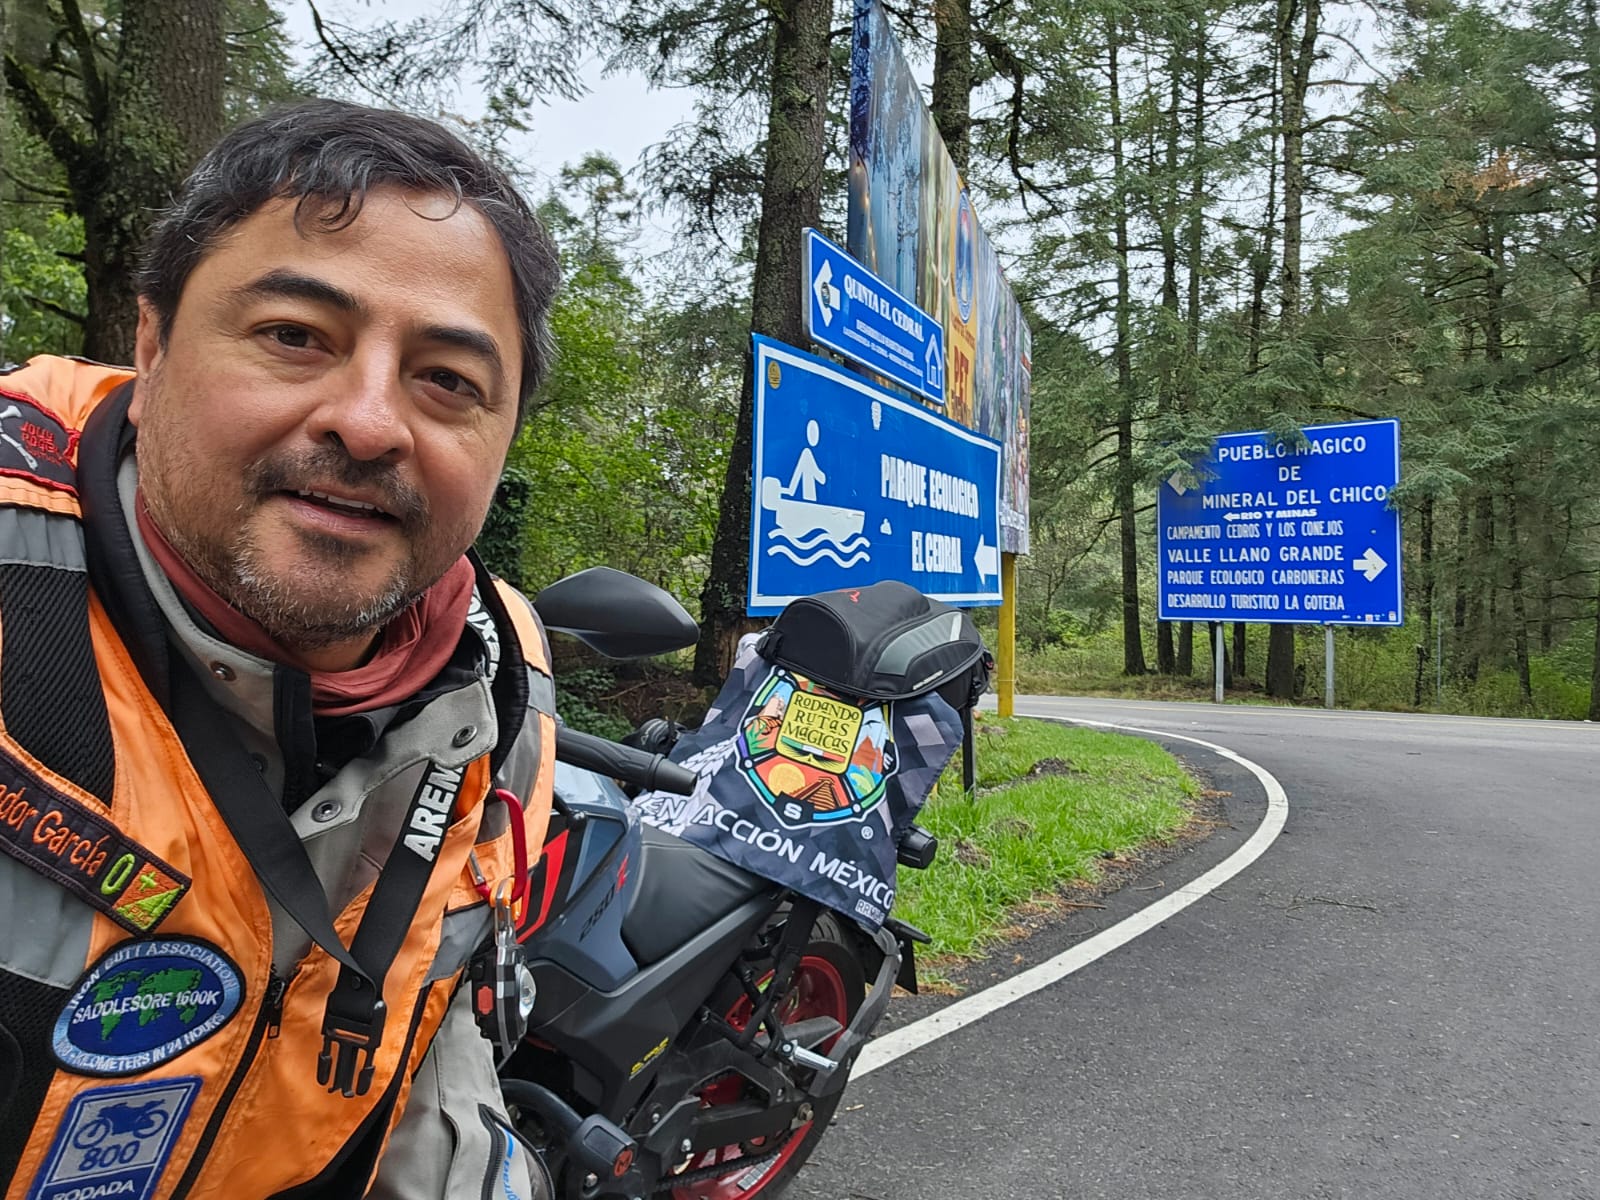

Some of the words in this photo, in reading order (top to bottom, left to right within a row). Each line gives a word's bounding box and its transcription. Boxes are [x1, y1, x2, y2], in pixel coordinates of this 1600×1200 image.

[844, 274, 879, 313] QUINTA
[880, 297, 891, 321] EL
[892, 307, 924, 342] CEDRAL
[1219, 442, 1286, 463] PUEBLO
[1296, 435, 1366, 456] MAGICO
[881, 454, 927, 508] PARQUE
[929, 469, 979, 519] ECOLOGICO
[1279, 466, 1301, 482] DE
[1203, 491, 1278, 509] MINERAL
[1286, 489, 1321, 506] DEL
[1330, 485, 1387, 503] CHICO
[1241, 511, 1262, 520] RIO
[1265, 510, 1274, 519] Y
[1275, 508, 1317, 518] MINAS
[1167, 523, 1220, 540] CAMPAMENTO
[1227, 522, 1260, 539] CEDROS
[1265, 522, 1273, 538] Y
[1278, 521, 1296, 537] LOS
[1301, 520, 1344, 536] CONEJOS
[912, 531, 925, 572] EL
[925, 532, 963, 574] CEDRAL
[1168, 549, 1211, 563] VALLE
[1220, 547, 1270, 563] LLANO
[1279, 545, 1344, 562] GRANDE
[1168, 570, 1204, 586] PARQUE
[1210, 570, 1265, 585] ECOLOGICO
[1272, 569, 1344, 585] CARBONERAS
[1168, 594, 1226, 609] DESARROLLO
[1231, 594, 1279, 610] TURISTICO
[1285, 595, 1299, 610] LA
[1304, 595, 1345, 610] GOTERA
[783, 802, 803, 820] S
[33, 810, 110, 877] García
[647, 797, 687, 820] EN
[692, 804, 804, 864] ACCIÓN
[809, 851, 894, 910] MÉXICO
[66, 970, 100, 1010] IRON
[146, 942, 238, 991] ASSOCIATION
[72, 991, 173, 1024] SADDLESORE
[175, 990, 221, 1005] 1600K
[153, 1047, 165, 1063] IN
[167, 1038, 182, 1054] 24
[183, 1012, 225, 1045] HOURS
[78, 1140, 140, 1171] 800
[52, 1179, 135, 1200] RODADA
